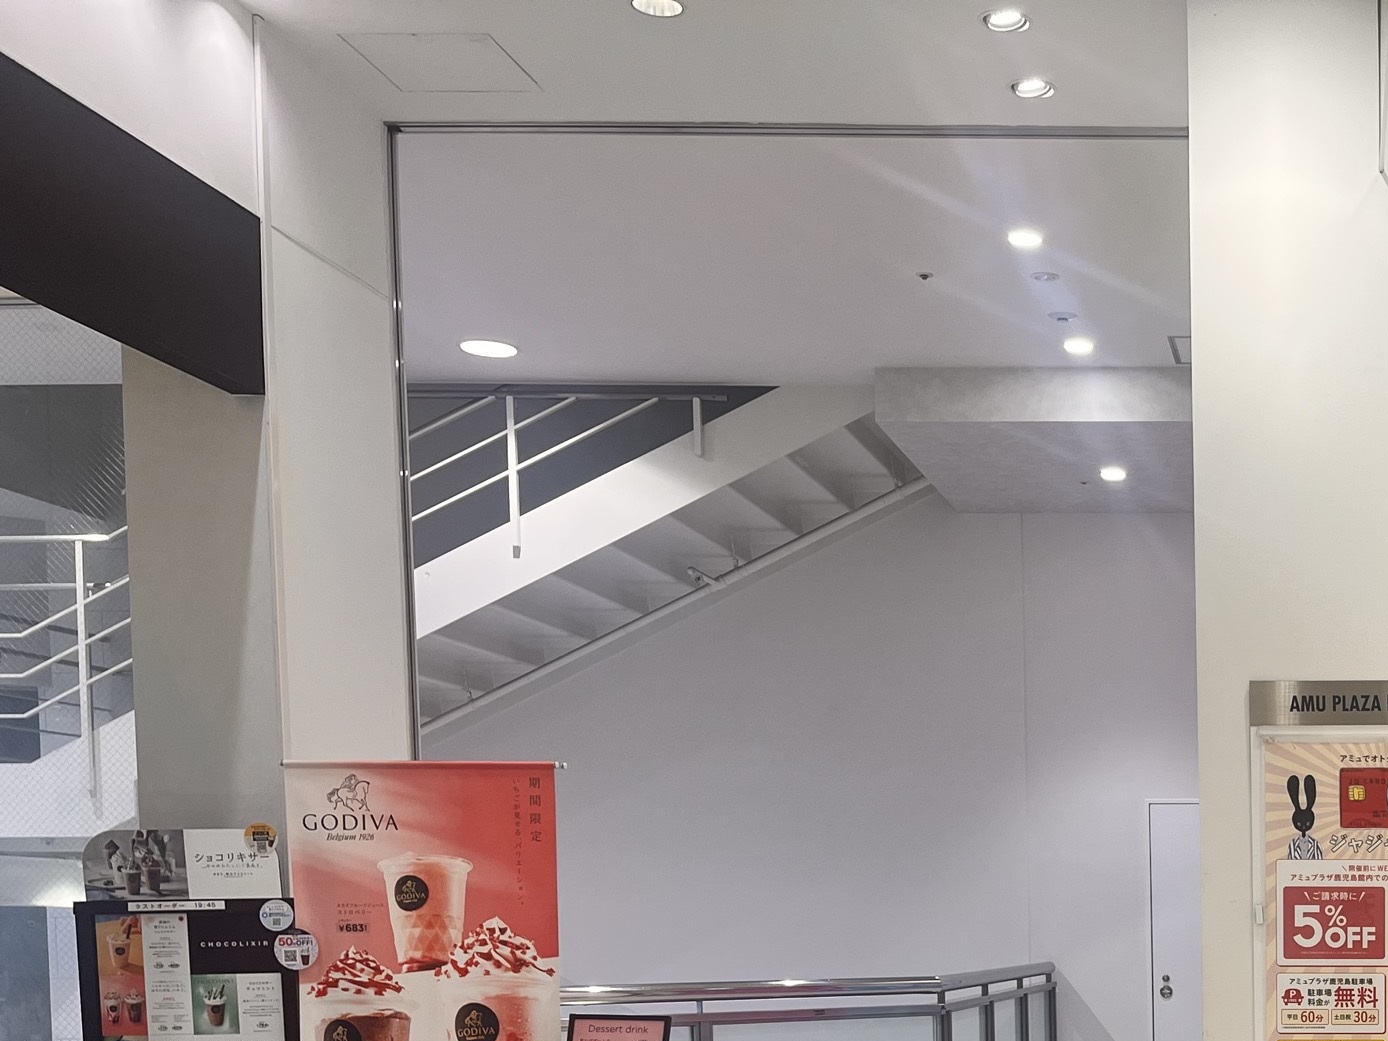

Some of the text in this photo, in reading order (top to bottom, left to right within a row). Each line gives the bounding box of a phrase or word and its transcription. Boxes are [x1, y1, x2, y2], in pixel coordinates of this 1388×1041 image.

[1290, 695, 1326, 712] AMU
[1332, 694, 1382, 712] PLAZA
[528, 776, 542, 842] 期間限定
[302, 813, 399, 831] GODIVA
[326, 832, 375, 841] Belgium 1926
[193, 852, 270, 863] ショコリキサー
[396, 893, 427, 901] GODIVA
[1324, 926, 1376, 949] OFF
[200, 940, 269, 948] CHOCOLIXIR
[1307, 986, 1379, 1008] 駐車場 無料
[1307, 998, 1330, 1006] 料金が
[1300, 1010, 1324, 1023] 60分
[1353, 1010, 1377, 1023] 30分
[457, 1027, 496, 1037] GODIVA
[588, 1024, 649, 1034] Dessert drink
